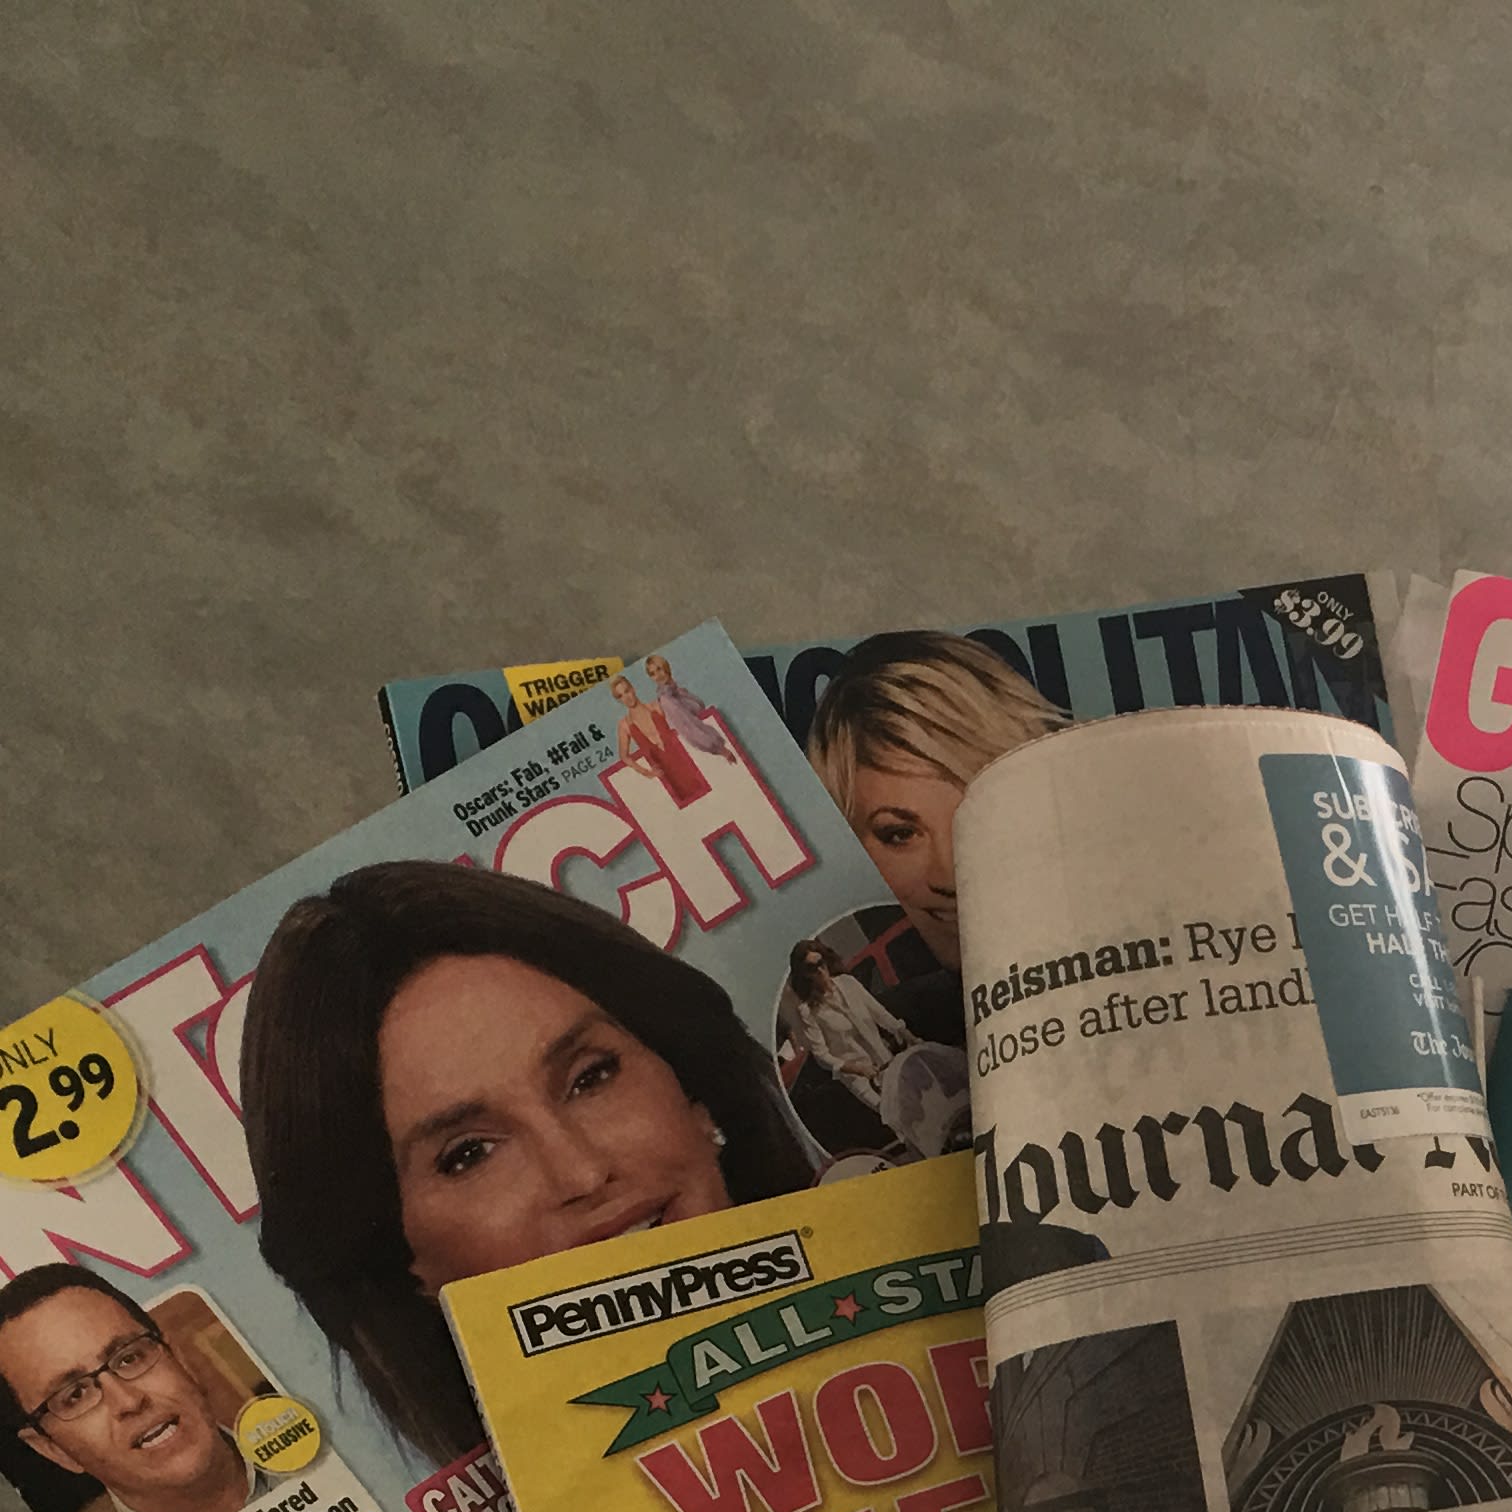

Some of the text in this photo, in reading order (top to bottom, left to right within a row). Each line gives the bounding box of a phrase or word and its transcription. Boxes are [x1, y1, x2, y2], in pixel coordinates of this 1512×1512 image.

[1273, 589, 1364, 660] $3.99
[1317, 591, 1354, 621] ONLY
[520, 664, 610, 698] TRIGGER
[453, 779, 515, 823] Oscars:
[511, 758, 551, 795] Fab,
[588, 723, 607, 742] &
[466, 745, 615, 839] Drunk Stars PAGE 24
[1321, 823, 1377, 888] &
[1328, 903, 1377, 928] GET
[971, 936, 1175, 1027] Reisman:
[1184, 921, 1277, 966] Rye
[0, 1027, 60, 1083] NLY
[977, 1018, 1065, 1079] close
[1078, 986, 1188, 1038] after
[1452, 1182, 1484, 1198] PART
[516, 1244, 802, 1350] PennyPress
[694, 1303, 833, 1389] ALL
[254, 1418, 316, 1464] EXCLUSIVE
